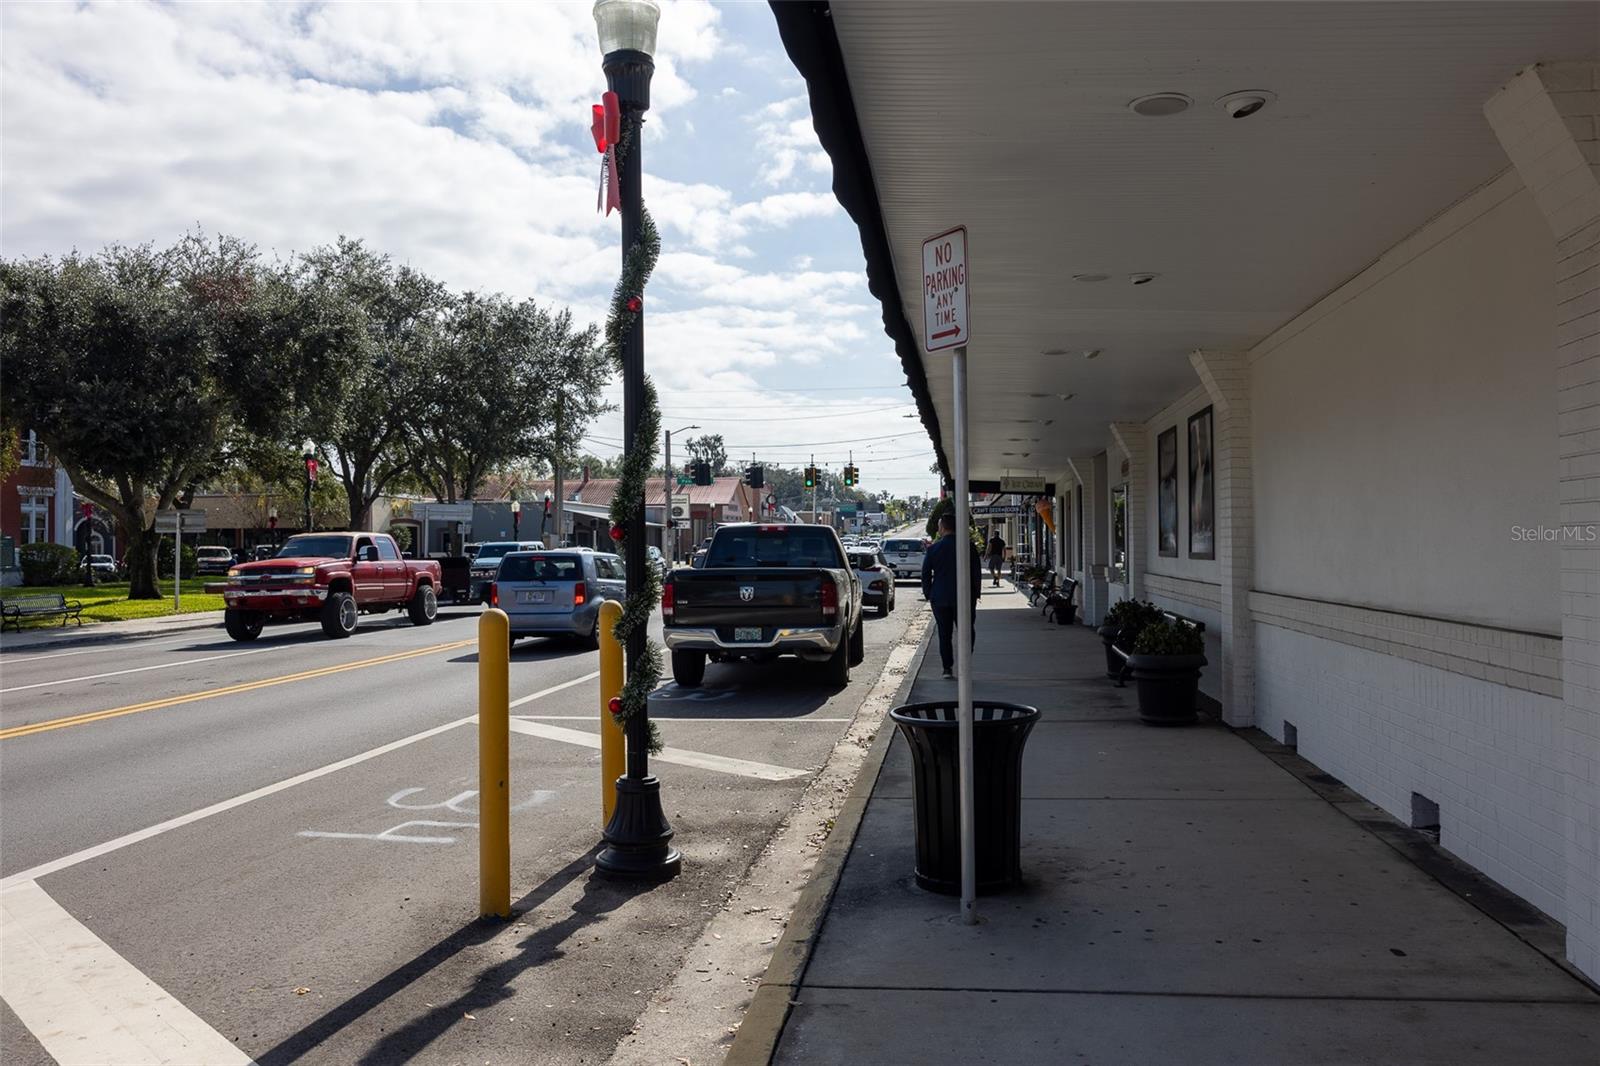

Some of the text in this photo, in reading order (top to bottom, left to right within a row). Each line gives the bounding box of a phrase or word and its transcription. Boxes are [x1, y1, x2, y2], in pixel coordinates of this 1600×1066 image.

[935, 242, 952, 266] NO
[926, 264, 964, 295] PARKING
[936, 291, 954, 309] ANY
[935, 308, 956, 326] TIME
